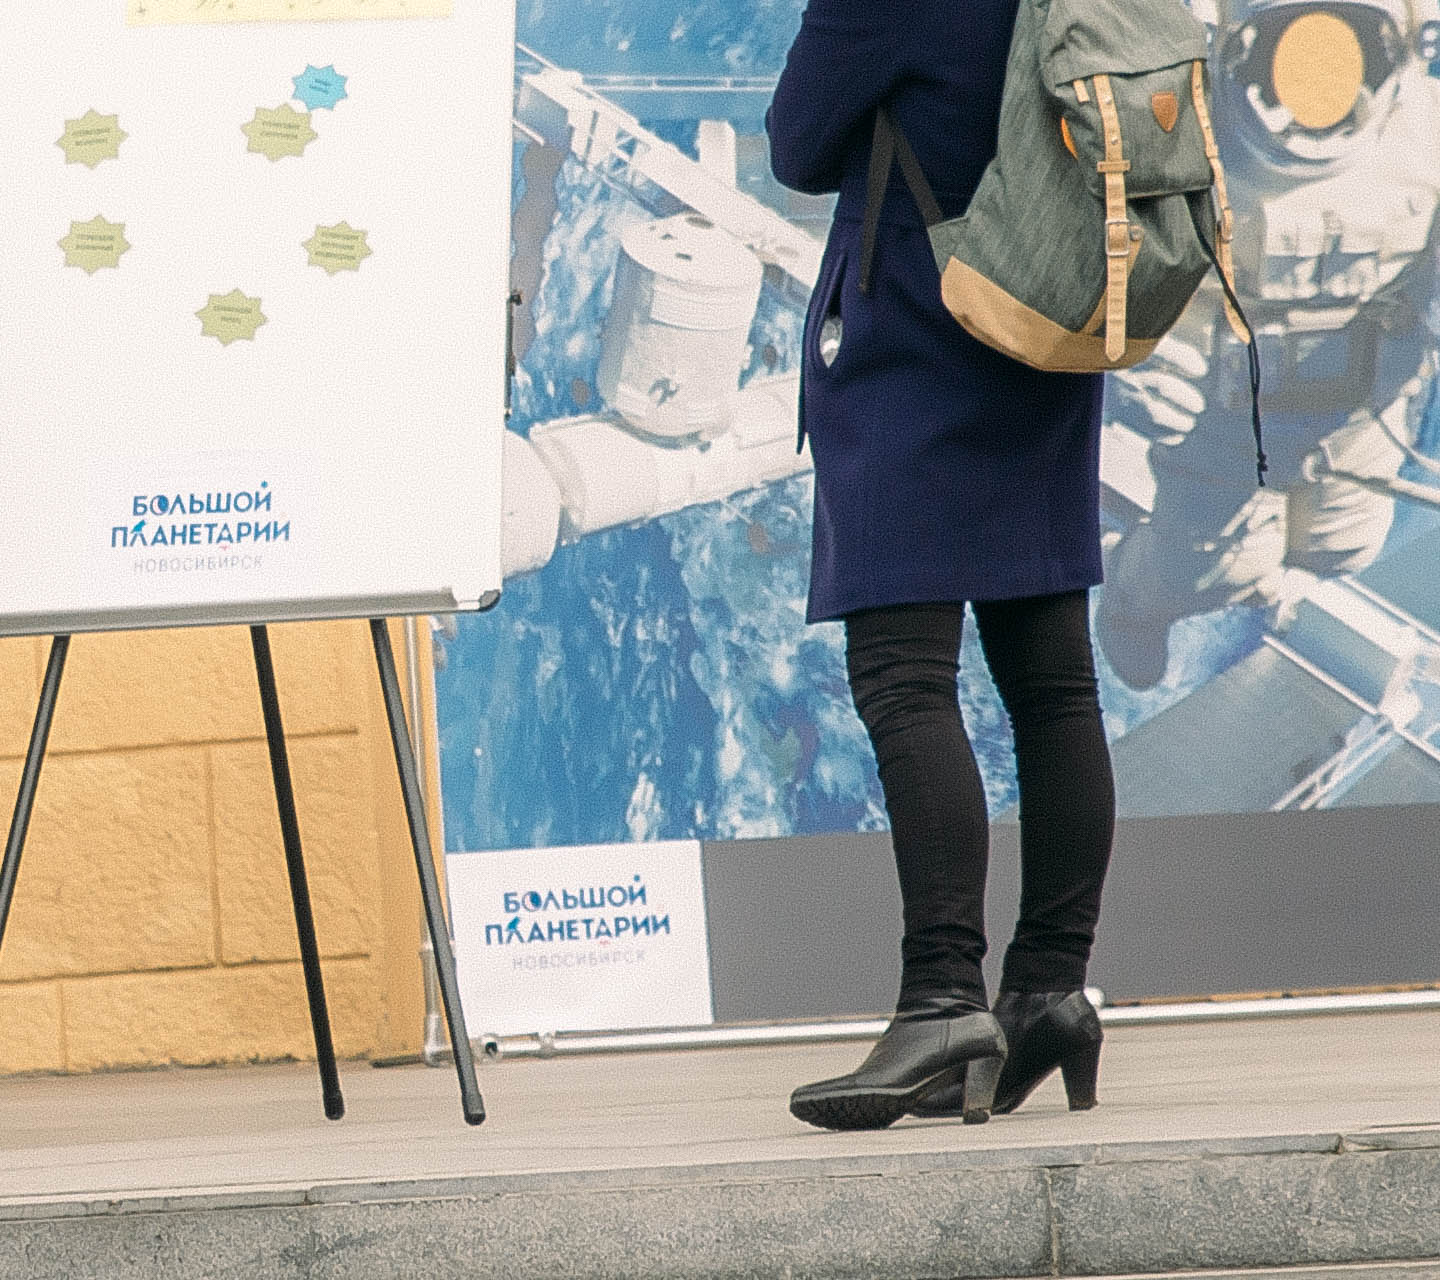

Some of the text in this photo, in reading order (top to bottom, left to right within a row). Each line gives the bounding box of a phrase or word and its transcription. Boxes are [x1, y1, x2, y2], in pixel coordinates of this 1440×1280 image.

[132, 480, 272, 516] БОЛЬШОЙ
[133, 555, 263, 574] НОВОСИБИРСК
[503, 874, 647, 914] БОЛЬШОЙ
[511, 949, 647, 971] НОВОСИБИРСК
